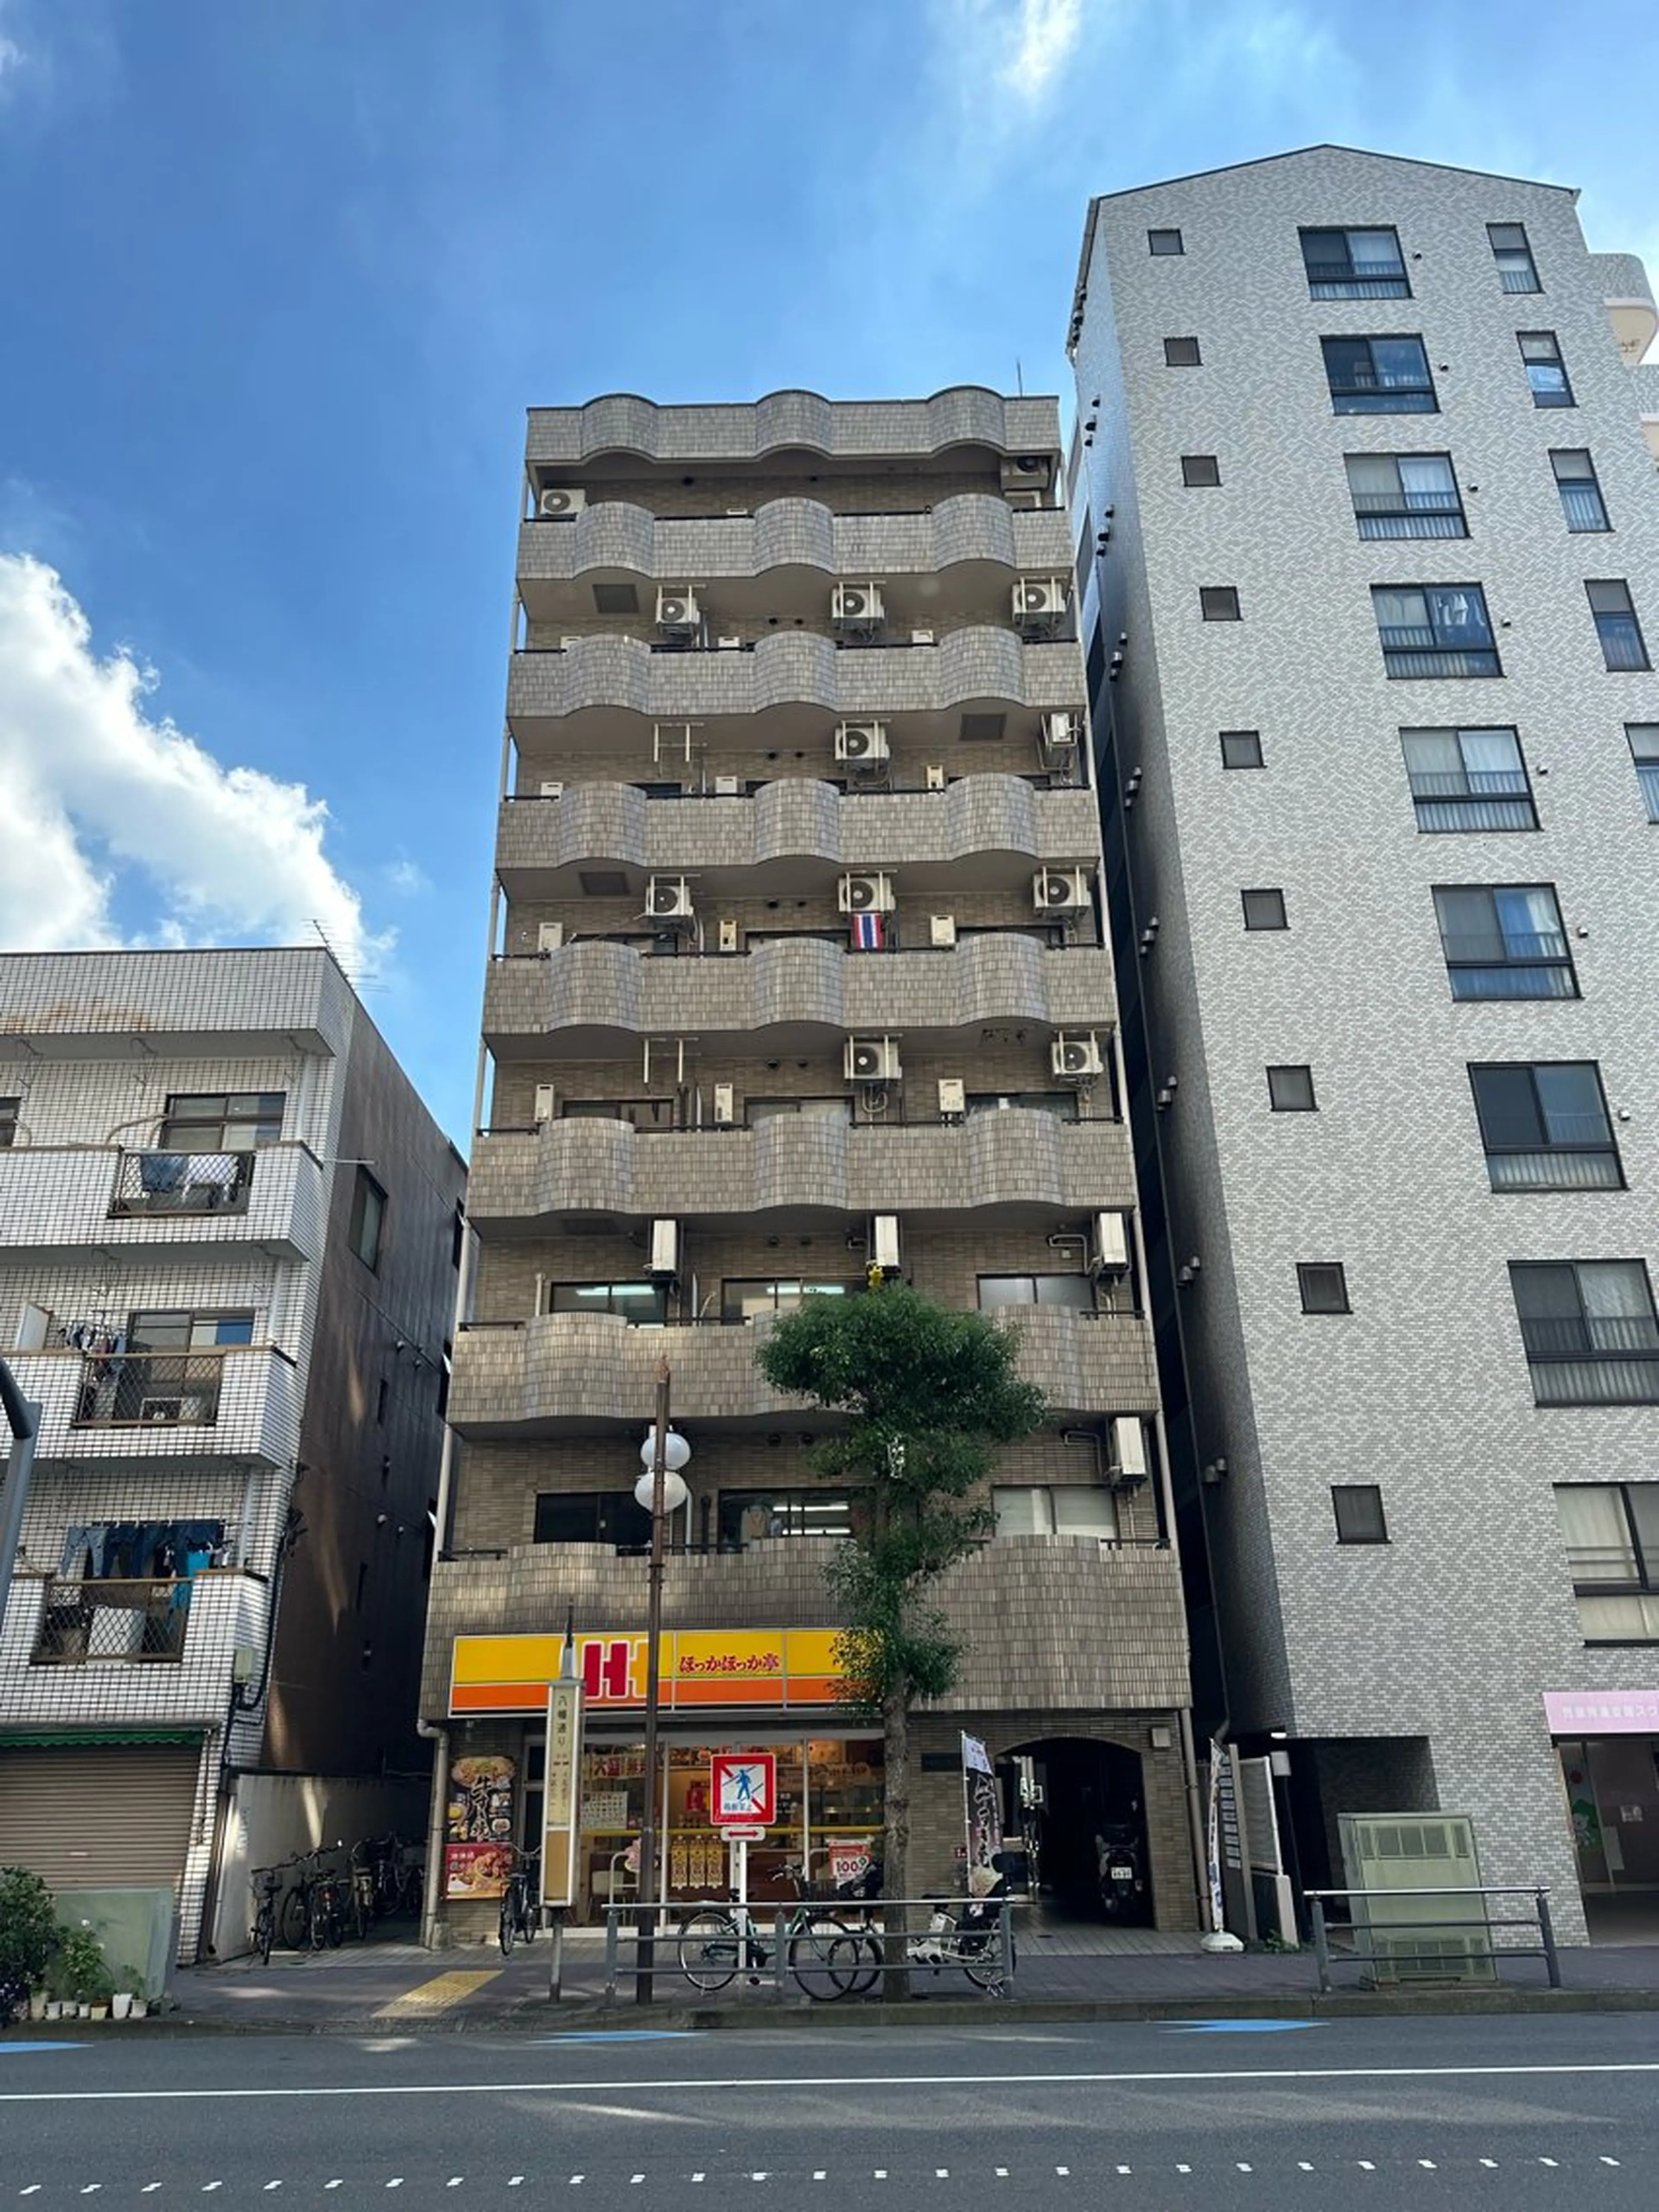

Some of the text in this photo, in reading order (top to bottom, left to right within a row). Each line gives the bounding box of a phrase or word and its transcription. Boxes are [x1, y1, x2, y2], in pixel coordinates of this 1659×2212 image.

[680, 1653, 779, 1672] ほっかほっか亭
